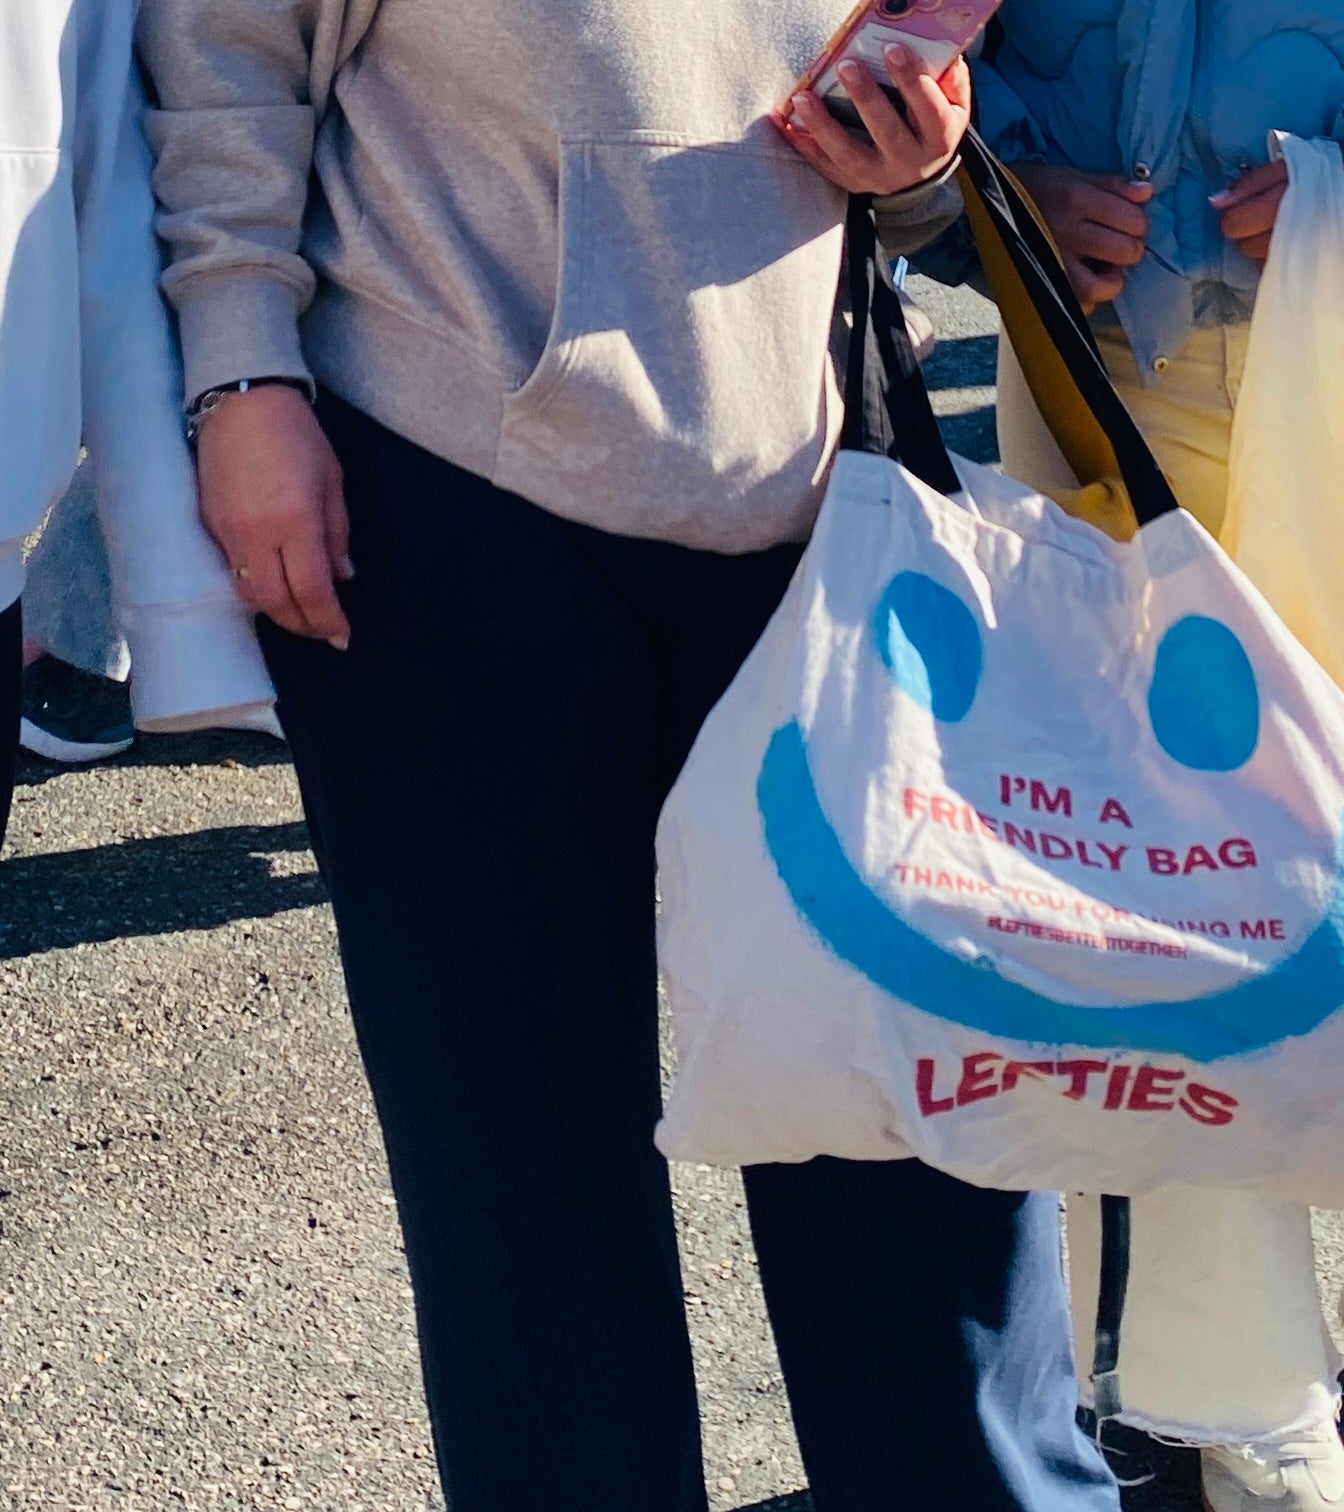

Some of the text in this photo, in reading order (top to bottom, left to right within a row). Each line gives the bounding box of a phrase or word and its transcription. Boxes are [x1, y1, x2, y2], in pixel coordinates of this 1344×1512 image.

[903, 786, 1258, 876] FRIENDLY BAG
[1099, 798, 1133, 829] A
[895, 863, 997, 897] THANK
[1006, 887, 1065, 911] YOU
[1074, 900, 1132, 922] FOR
[1239, 919, 1286, 940] ME
[916, 1052, 1240, 1126] LEFTIES
